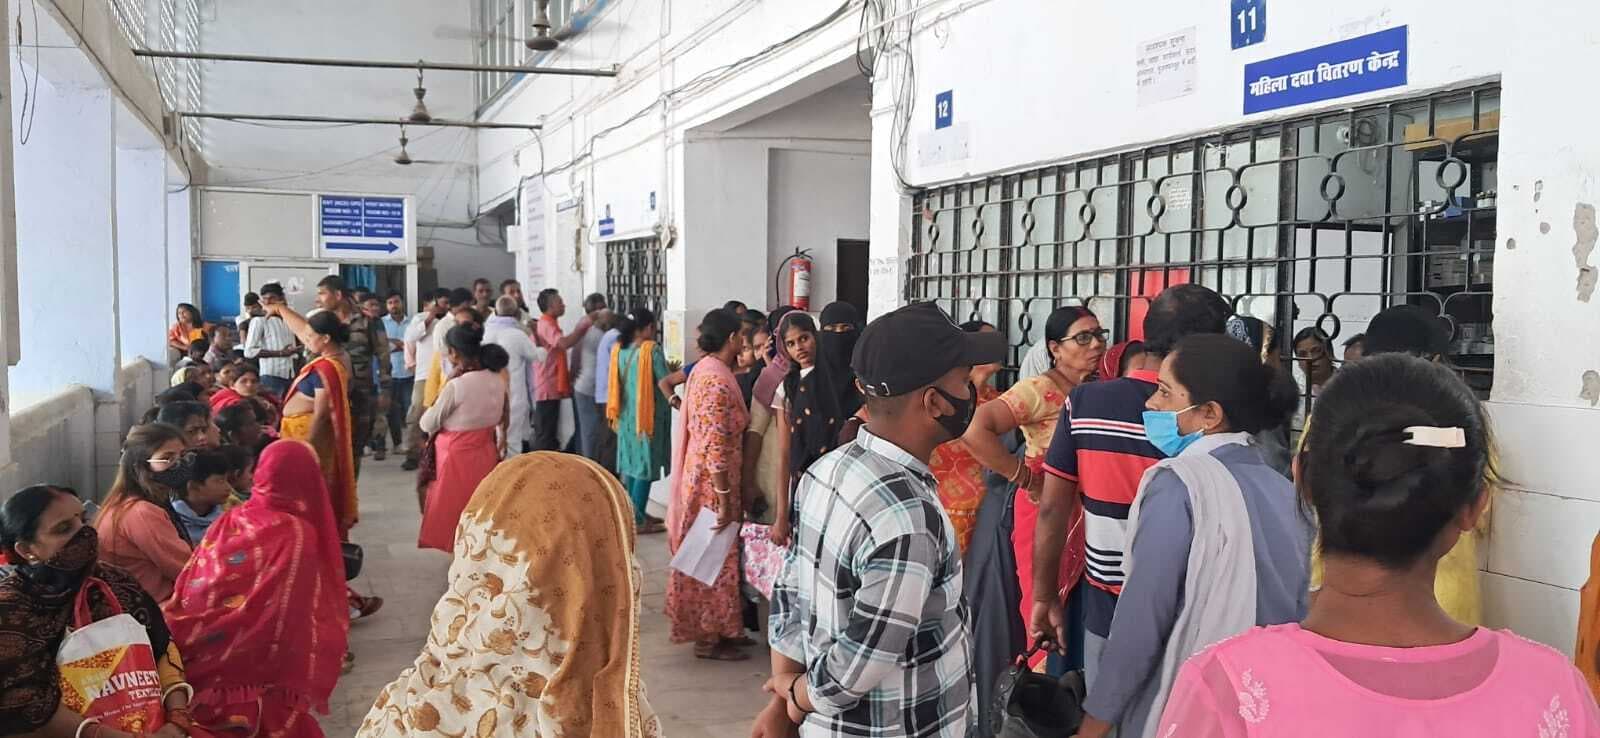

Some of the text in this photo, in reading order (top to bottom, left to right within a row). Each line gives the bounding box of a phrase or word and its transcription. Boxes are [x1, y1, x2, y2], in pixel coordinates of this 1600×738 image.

[1237, 6, 1257, 34] 11
[1249, 50, 1400, 97] महिला दवा वितरण केन्द्र
[938, 100, 948, 118] 12
